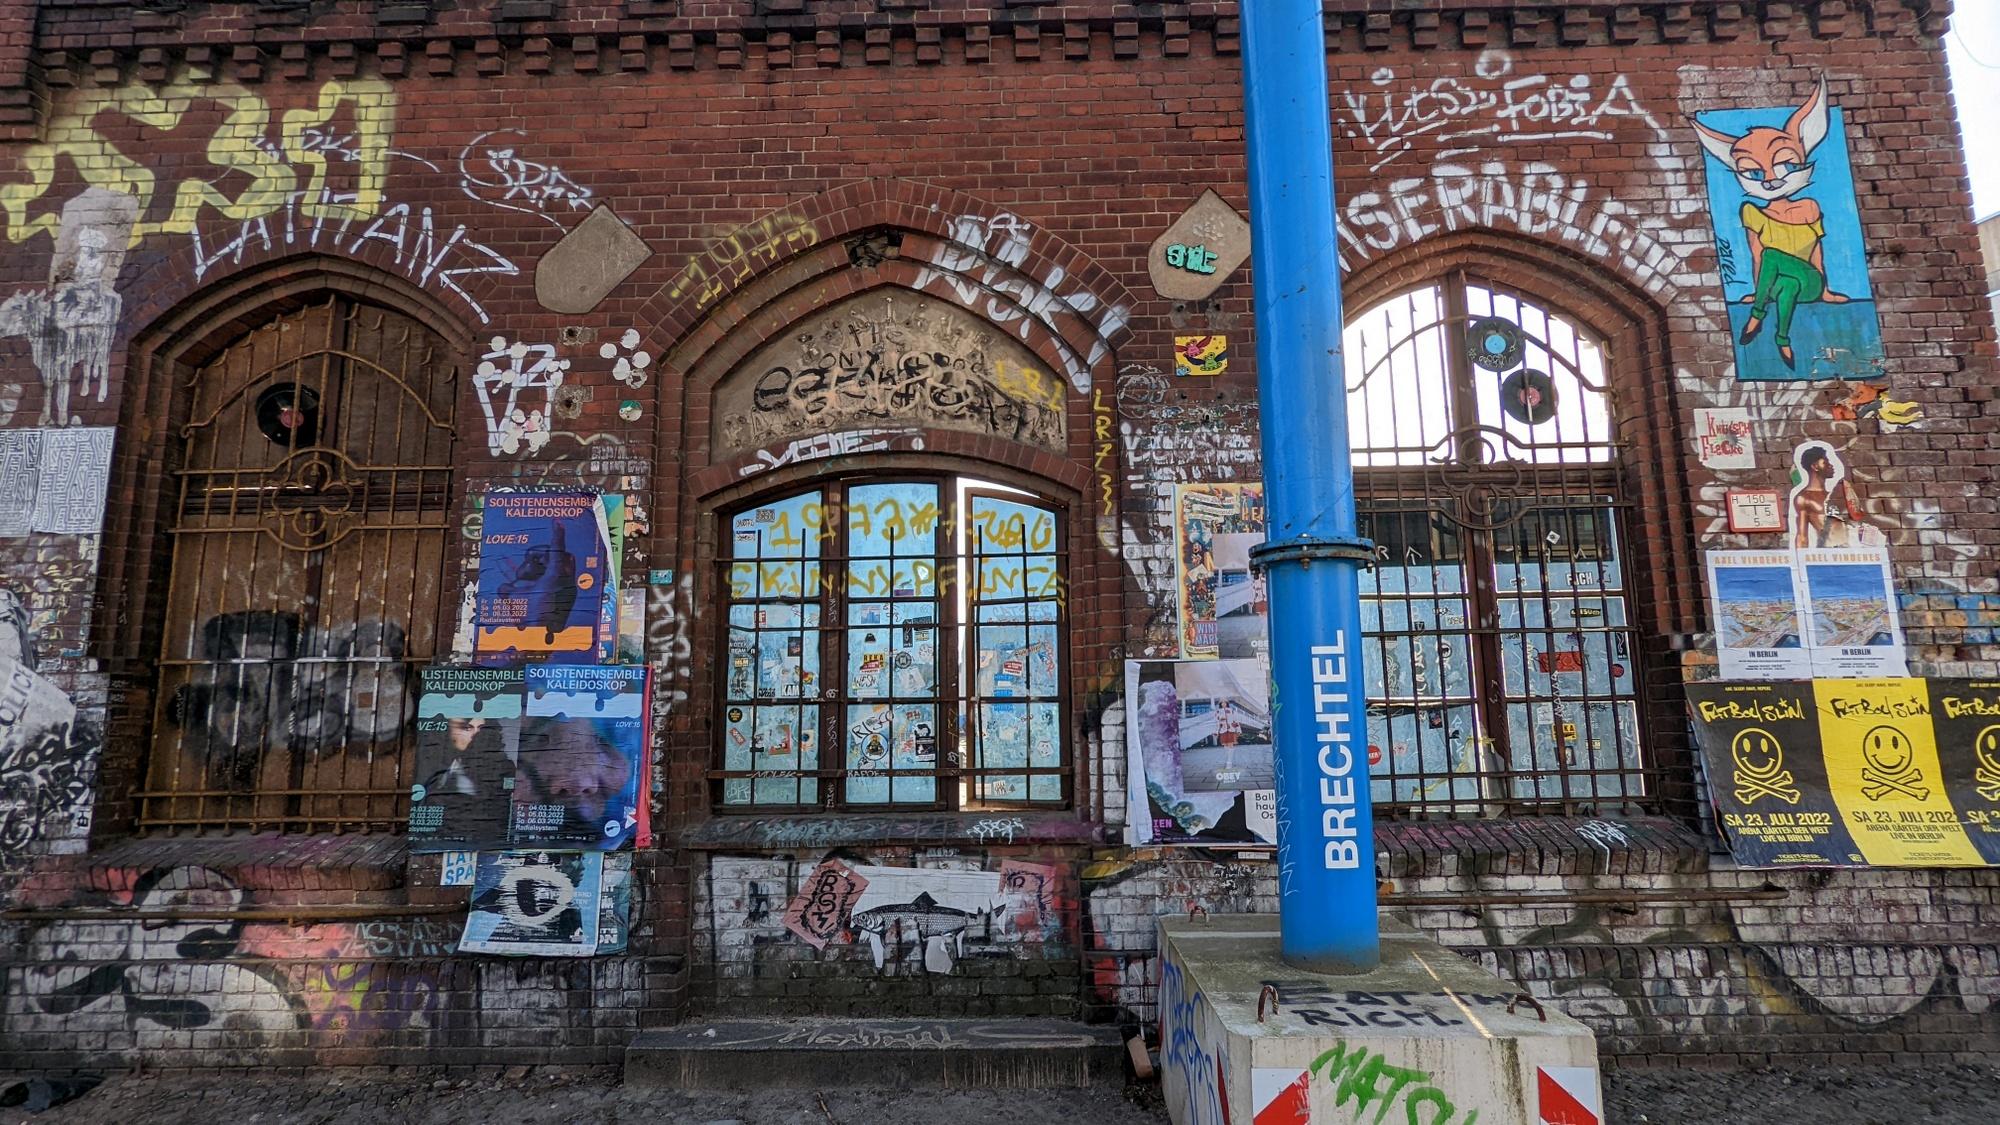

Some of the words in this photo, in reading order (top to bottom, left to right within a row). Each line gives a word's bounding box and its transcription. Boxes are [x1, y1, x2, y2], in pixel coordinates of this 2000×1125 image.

[1747, 495, 1766, 504] 150
[506, 508, 584, 518] KALEIDOSKOP
[485, 534, 529, 545] LOVE:15
[1714, 556, 1737, 565] AXEL
[1741, 555, 1790, 564] VINDENES
[1805, 554, 1829, 562] AXEL
[1832, 553, 1881, 562] VINDENES
[1756, 650, 1779, 658] BERLIN
[1850, 648, 1872, 656] BERLIN
[529, 668, 645, 680] SOLISTENENSEMBLE
[425, 681, 505, 691] KALEIDOSKOP
[547, 680, 627, 690] KALEIDOSKOP
[1311, 629, 1360, 869] BRECHTEL
[1216, 771, 1241, 780] OBEY
[1255, 793, 1274, 801] Ball
[1261, 811, 1276, 819] Os
[1724, 813, 1744, 826] SA
[1745, 813, 1767, 826] 23.
[1769, 813, 1795, 825] JULI
[1795, 812, 1833, 825] 2022
[1852, 811, 1871, 823] SA
[1873, 811, 1896, 823] 23.
[1900, 811, 1924, 823] JULI
[1966, 810, 1990, 824] SA
[1738, 826, 1761, 835] ARENA
[1792, 826, 1809, 834] DER
[1809, 826, 1830, 834] WELT
[1866, 824, 1891, 832] ARENA
[1923, 824, 1940, 832] DER
[1941, 824, 1962, 832] WELT
[1788, 834, 1815, 842] BERLIN
[1890, 832, 1908, 840] LIVE
[1916, 832, 1946, 840] BERLIN
